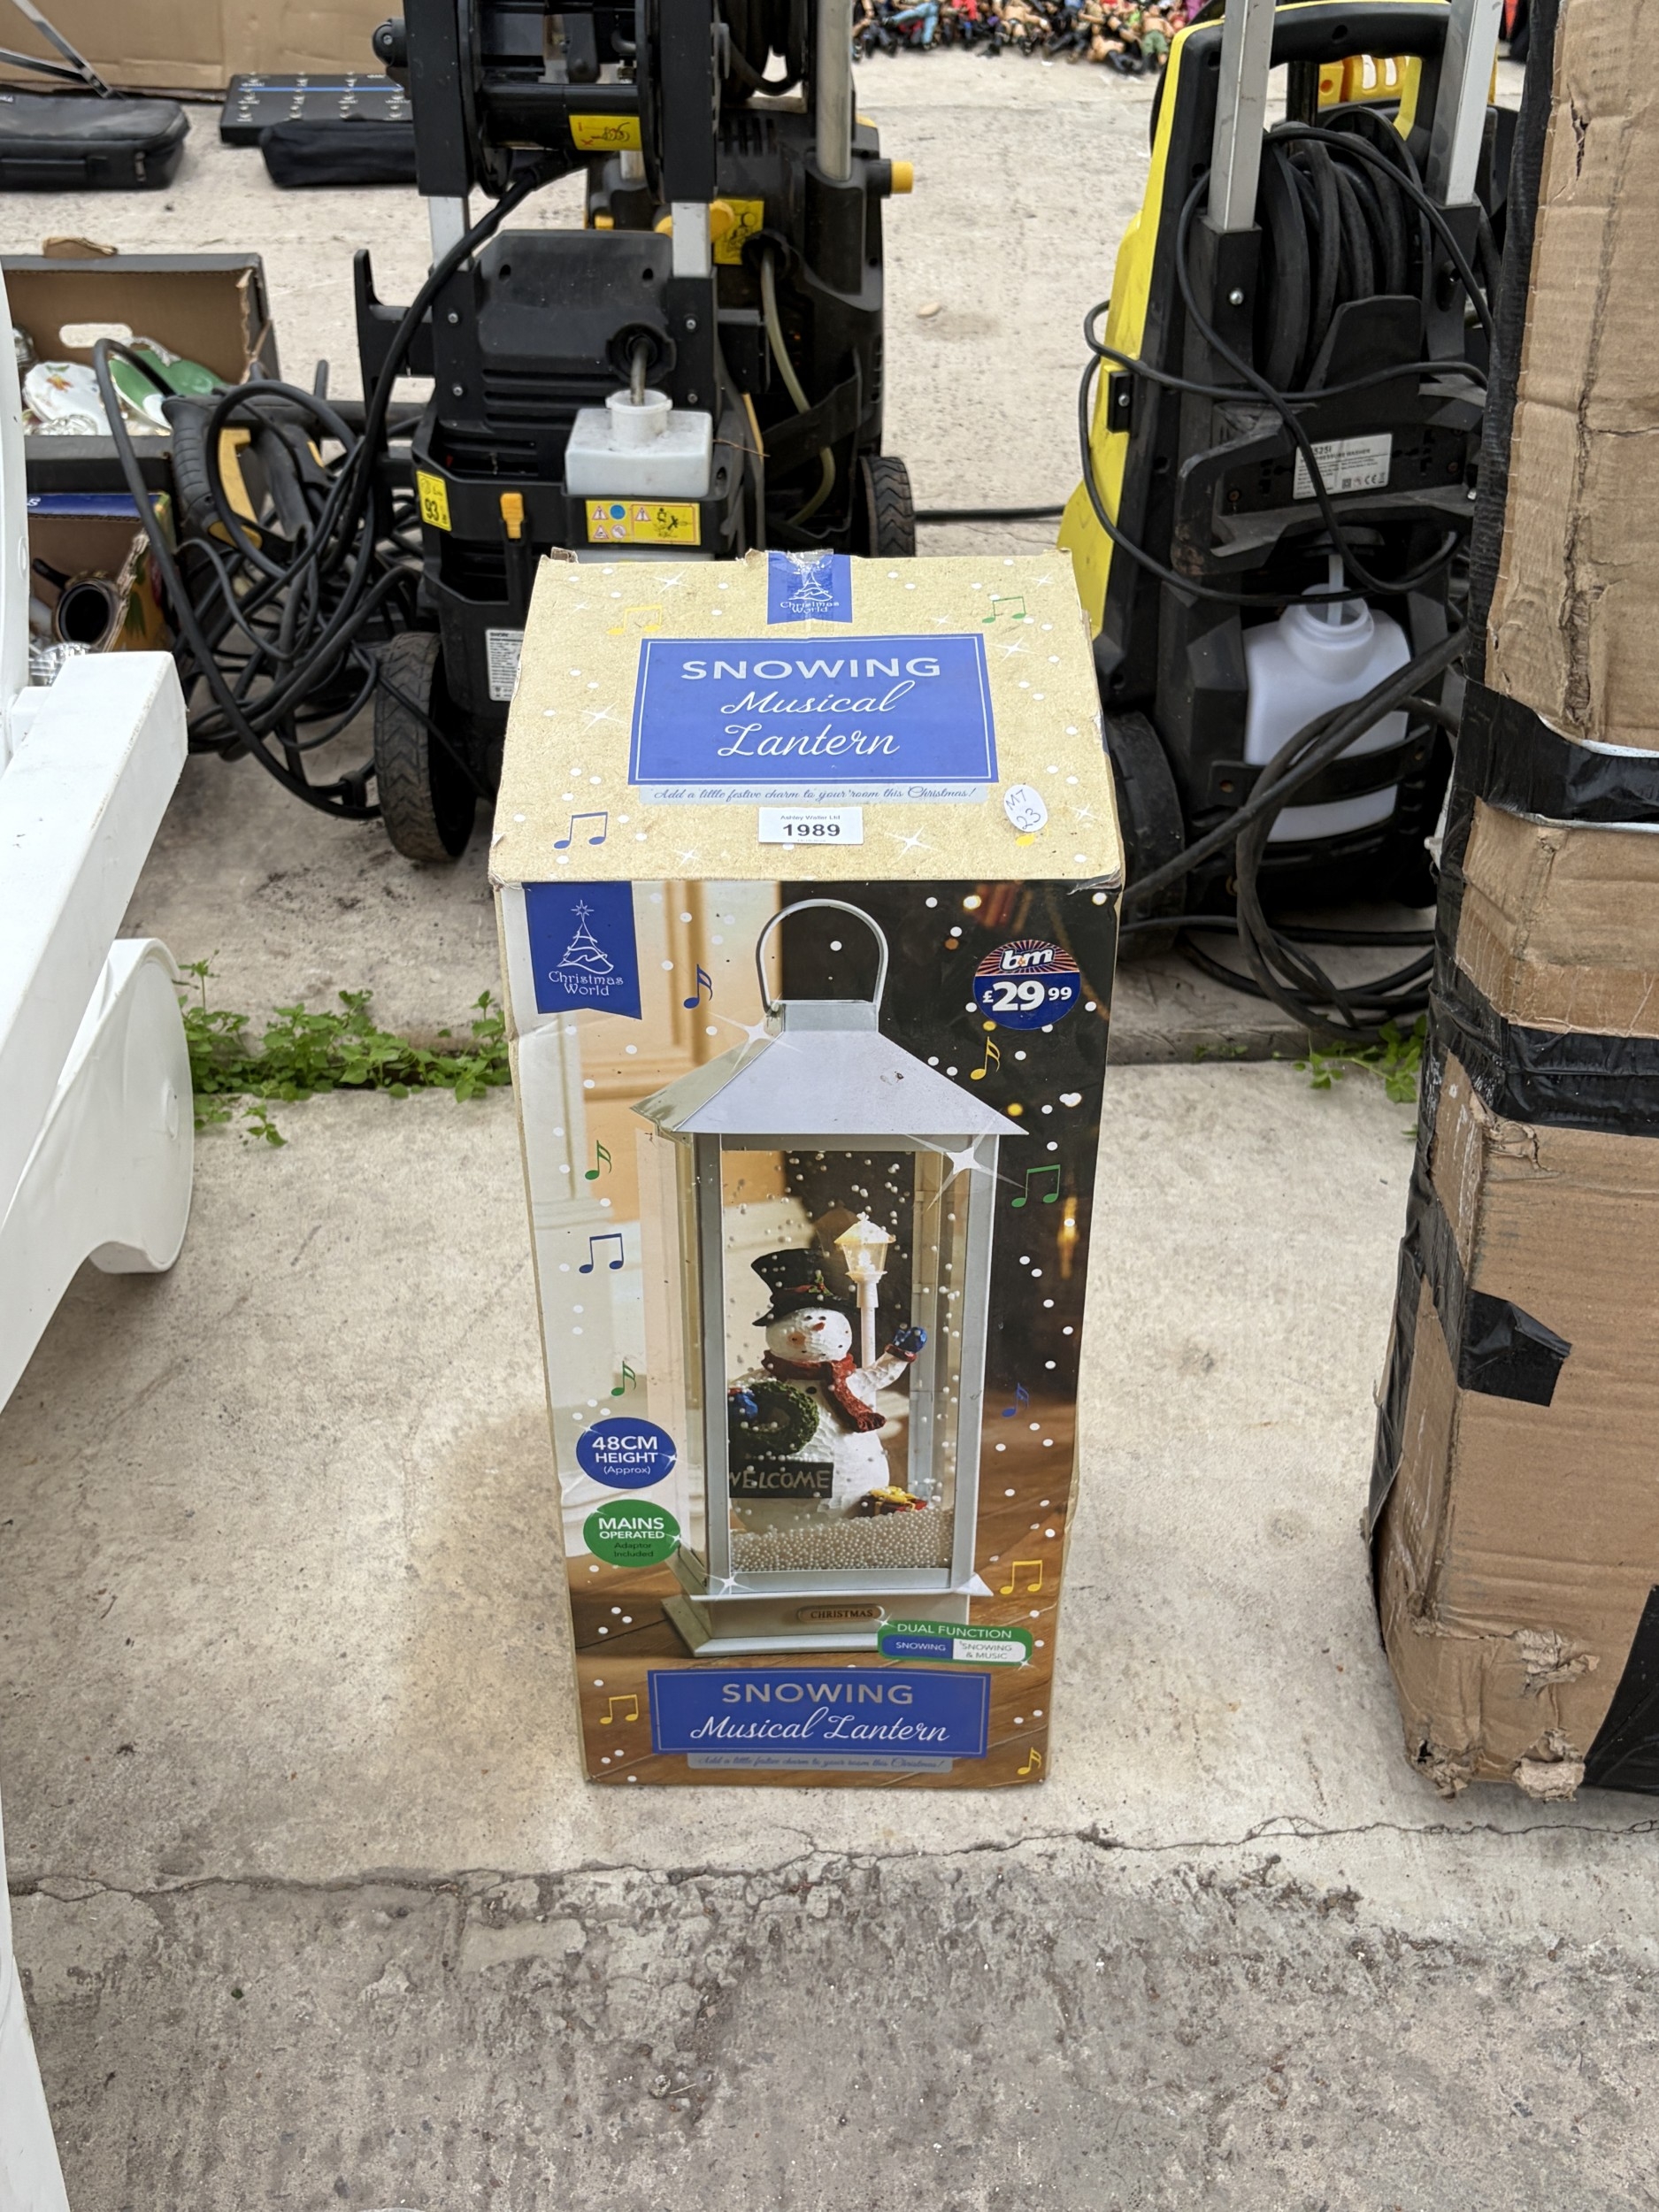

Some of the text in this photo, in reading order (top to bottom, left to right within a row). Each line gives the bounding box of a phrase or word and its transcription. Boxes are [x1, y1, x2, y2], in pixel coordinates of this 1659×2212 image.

[425, 497, 440, 522] 93
[792, 604, 828, 614] World
[680, 657, 941, 680] SNOWING
[719, 680, 916, 715] Musical
[717, 723, 901, 757] Lantern
[654, 788, 685, 799] Add
[699, 788, 726, 799] little
[726, 788, 761, 803] festive
[764, 788, 799, 799] charm
[803, 788, 815, 798] to
[815, 790, 847, 803] your
[883, 788, 903, 798] this
[907, 786, 977, 799] Christmas!
[1016, 808, 1041, 830] 23
[782, 824, 841, 837] 1989
[549, 971, 624, 985] Christmas
[564, 983, 610, 996] World
[592, 1436, 658, 1451] 48CM
[595, 1452, 659, 1463] HEIGHT
[603, 1465, 651, 1475] (Approx)
[598, 1517, 664, 1530] MAINS
[599, 1531, 665, 1540] OPERATED
[810, 1609, 873, 1619] CHRISTMAS
[896, 1624, 1012, 1639] DUAL FUNCTION
[895, 1641, 947, 1652] SNOWING
[962, 1642, 1013, 1652] SNOWING
[721, 1683, 914, 1705] SNOWING
[689, 1706, 950, 1741] Musical Lantern
